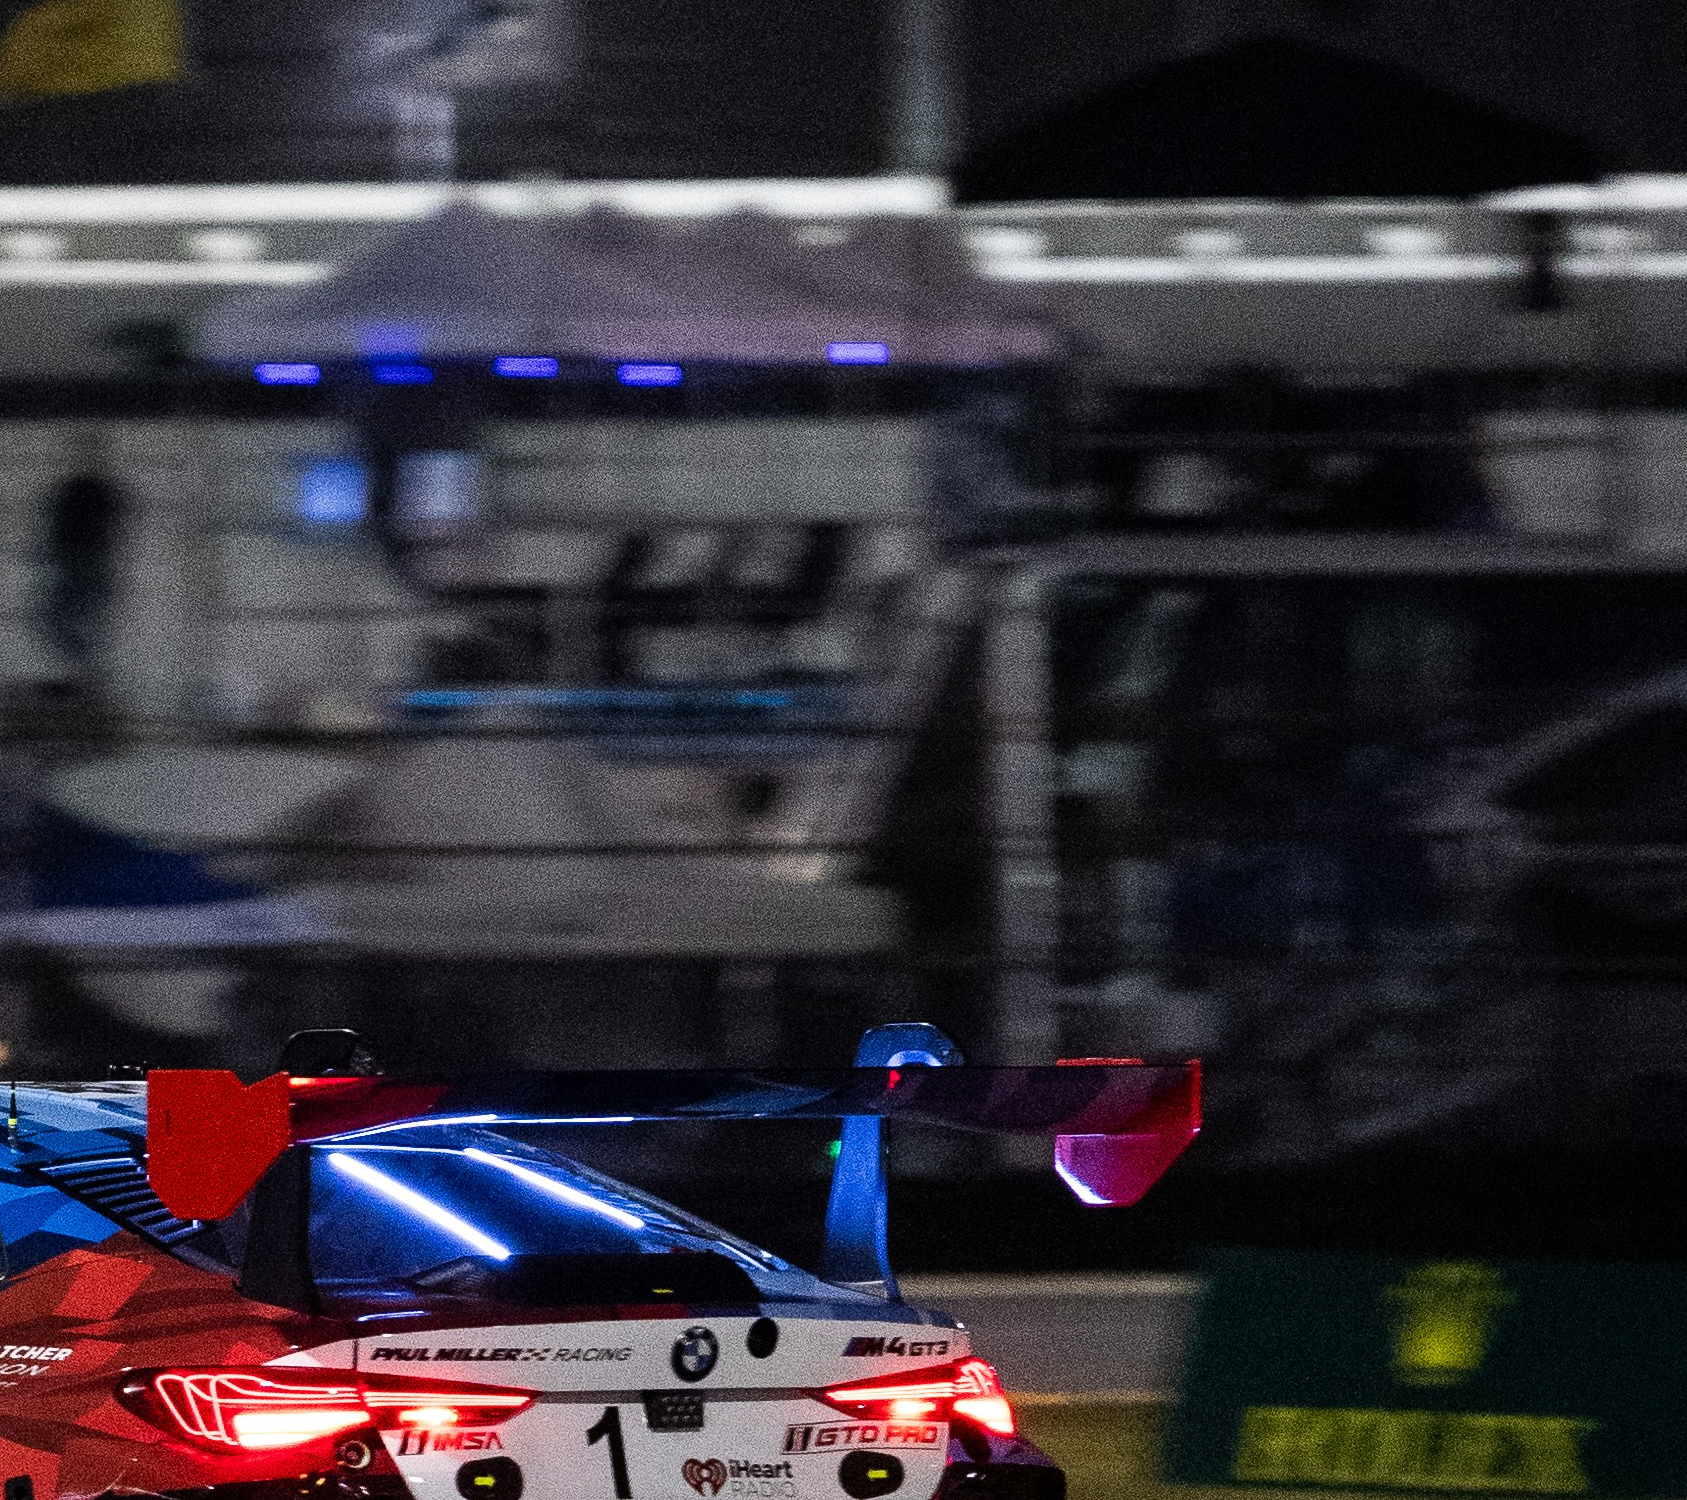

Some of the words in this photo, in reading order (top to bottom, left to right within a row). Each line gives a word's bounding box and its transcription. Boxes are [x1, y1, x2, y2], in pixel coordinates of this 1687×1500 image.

[432, 1347, 518, 1362] MILLER
[552, 1347, 632, 1362] RACING
[908, 1340, 948, 1357] GT3
[815, 1426, 879, 1448] GTD
[885, 1425, 938, 1444] PRO
[586, 1405, 633, 1500] 1
[728, 1458, 794, 1479] iHeart
